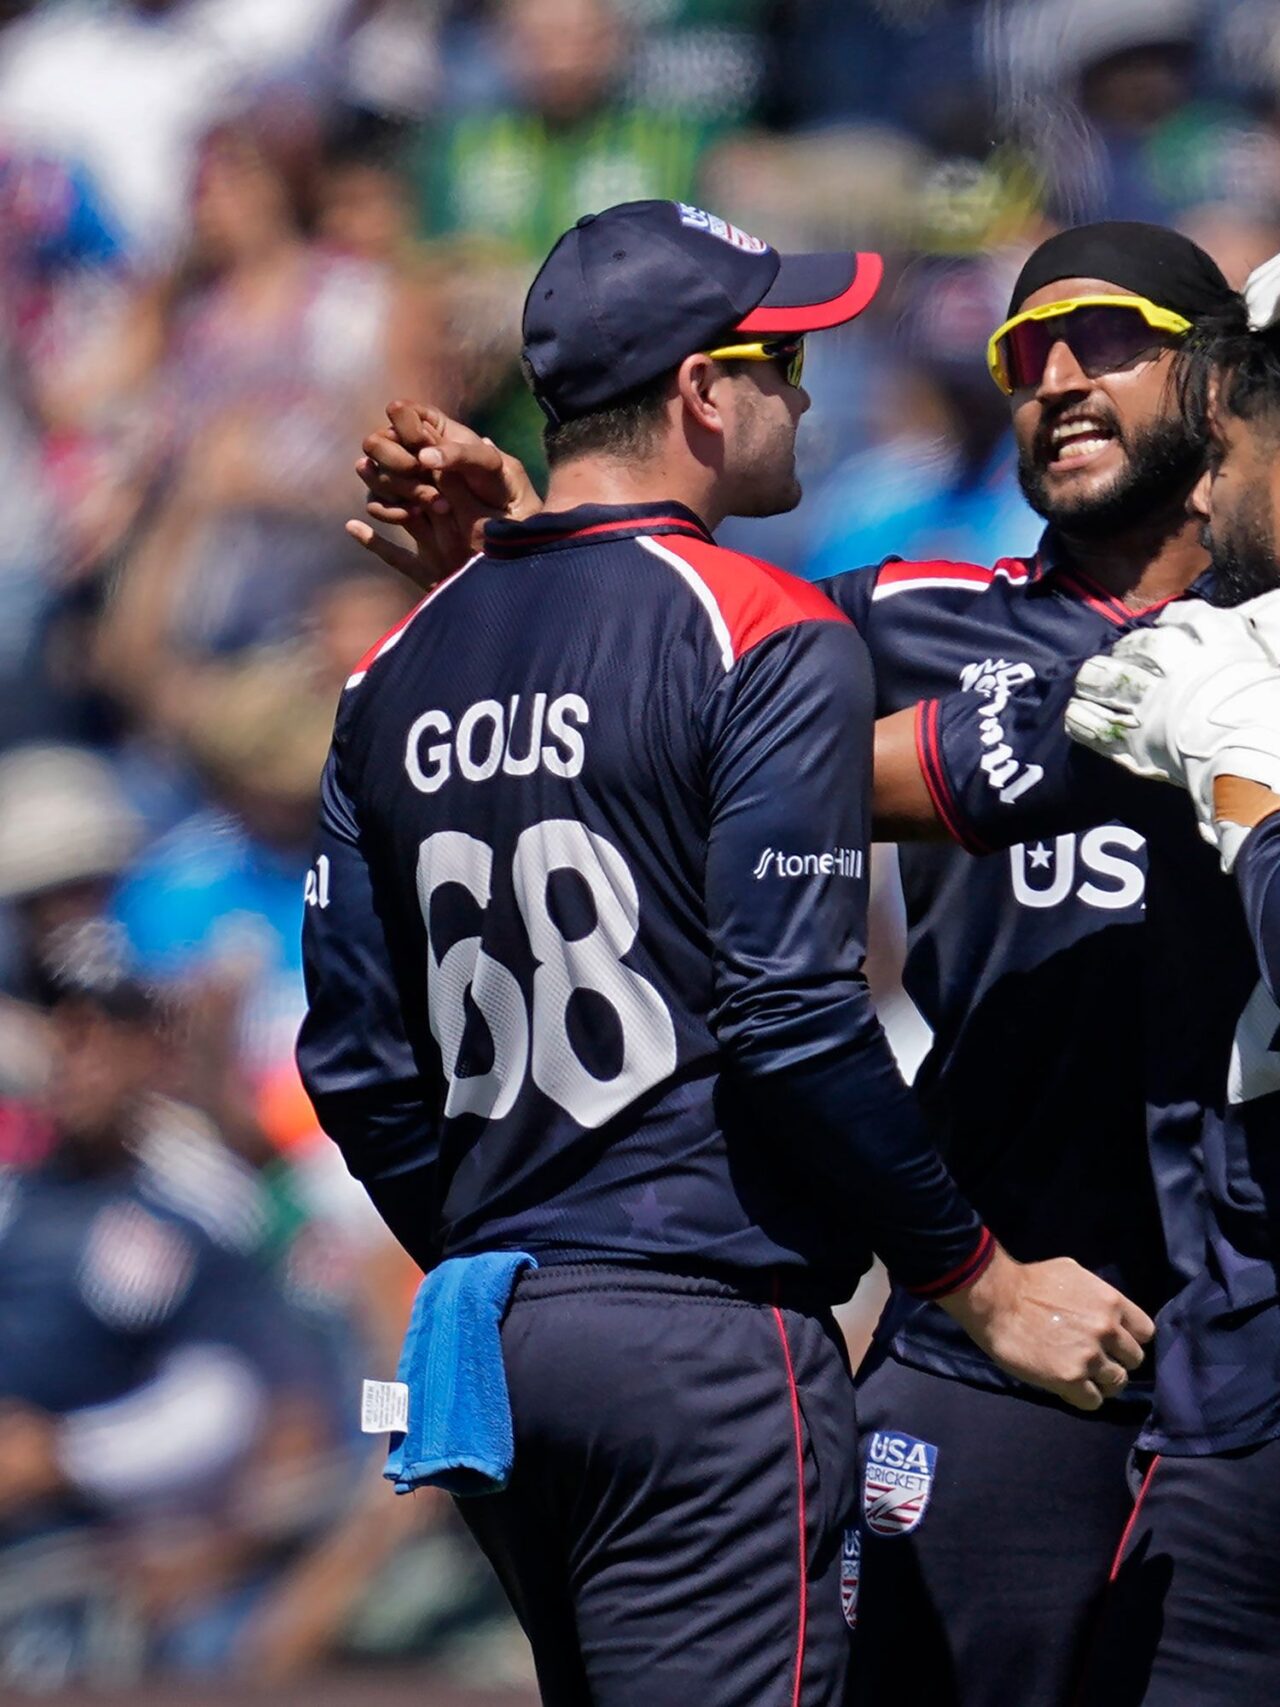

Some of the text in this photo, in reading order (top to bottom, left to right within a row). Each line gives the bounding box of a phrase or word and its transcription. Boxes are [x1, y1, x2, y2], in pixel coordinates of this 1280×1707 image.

[405, 692, 590, 793] GOUS
[1010, 825, 1147, 909] US
[416, 819, 678, 1128] 68
[866, 1465, 925, 1491] CRICKET
[869, 1432, 929, 1473] USA
